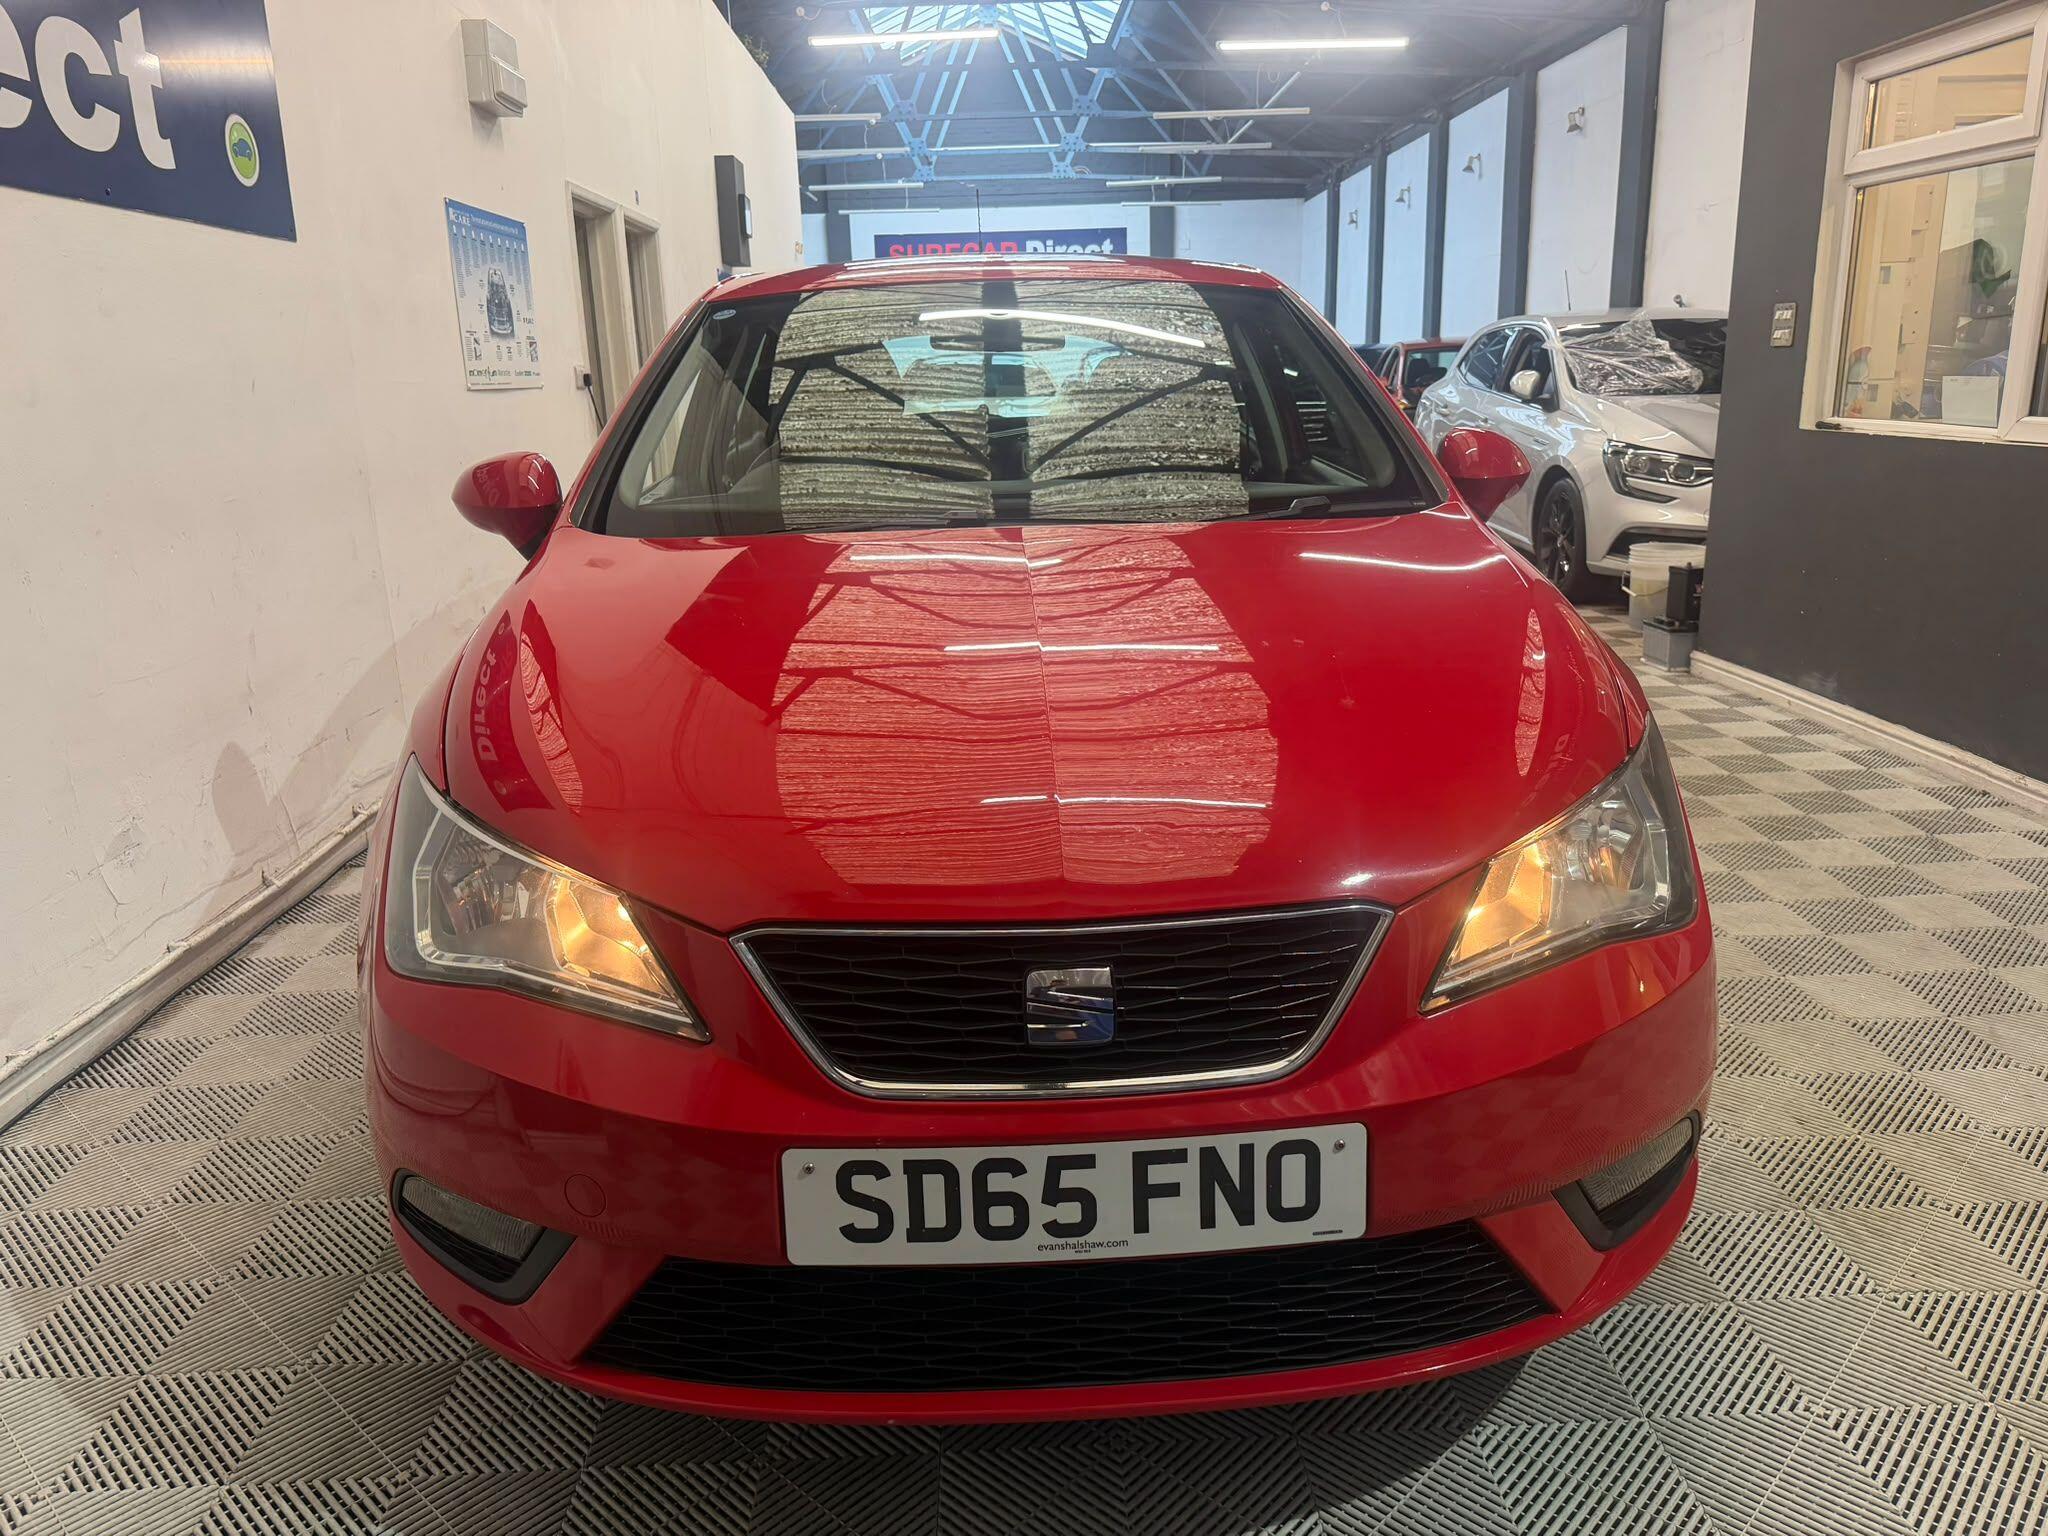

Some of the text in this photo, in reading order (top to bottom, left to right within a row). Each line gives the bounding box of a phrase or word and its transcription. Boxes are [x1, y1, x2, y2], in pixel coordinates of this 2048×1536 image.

[1025, 238, 1114, 254] Direct
[835, 1138, 1321, 1243] SD65 FNO
[1037, 1239, 1129, 1251] evanshalshaw.com
